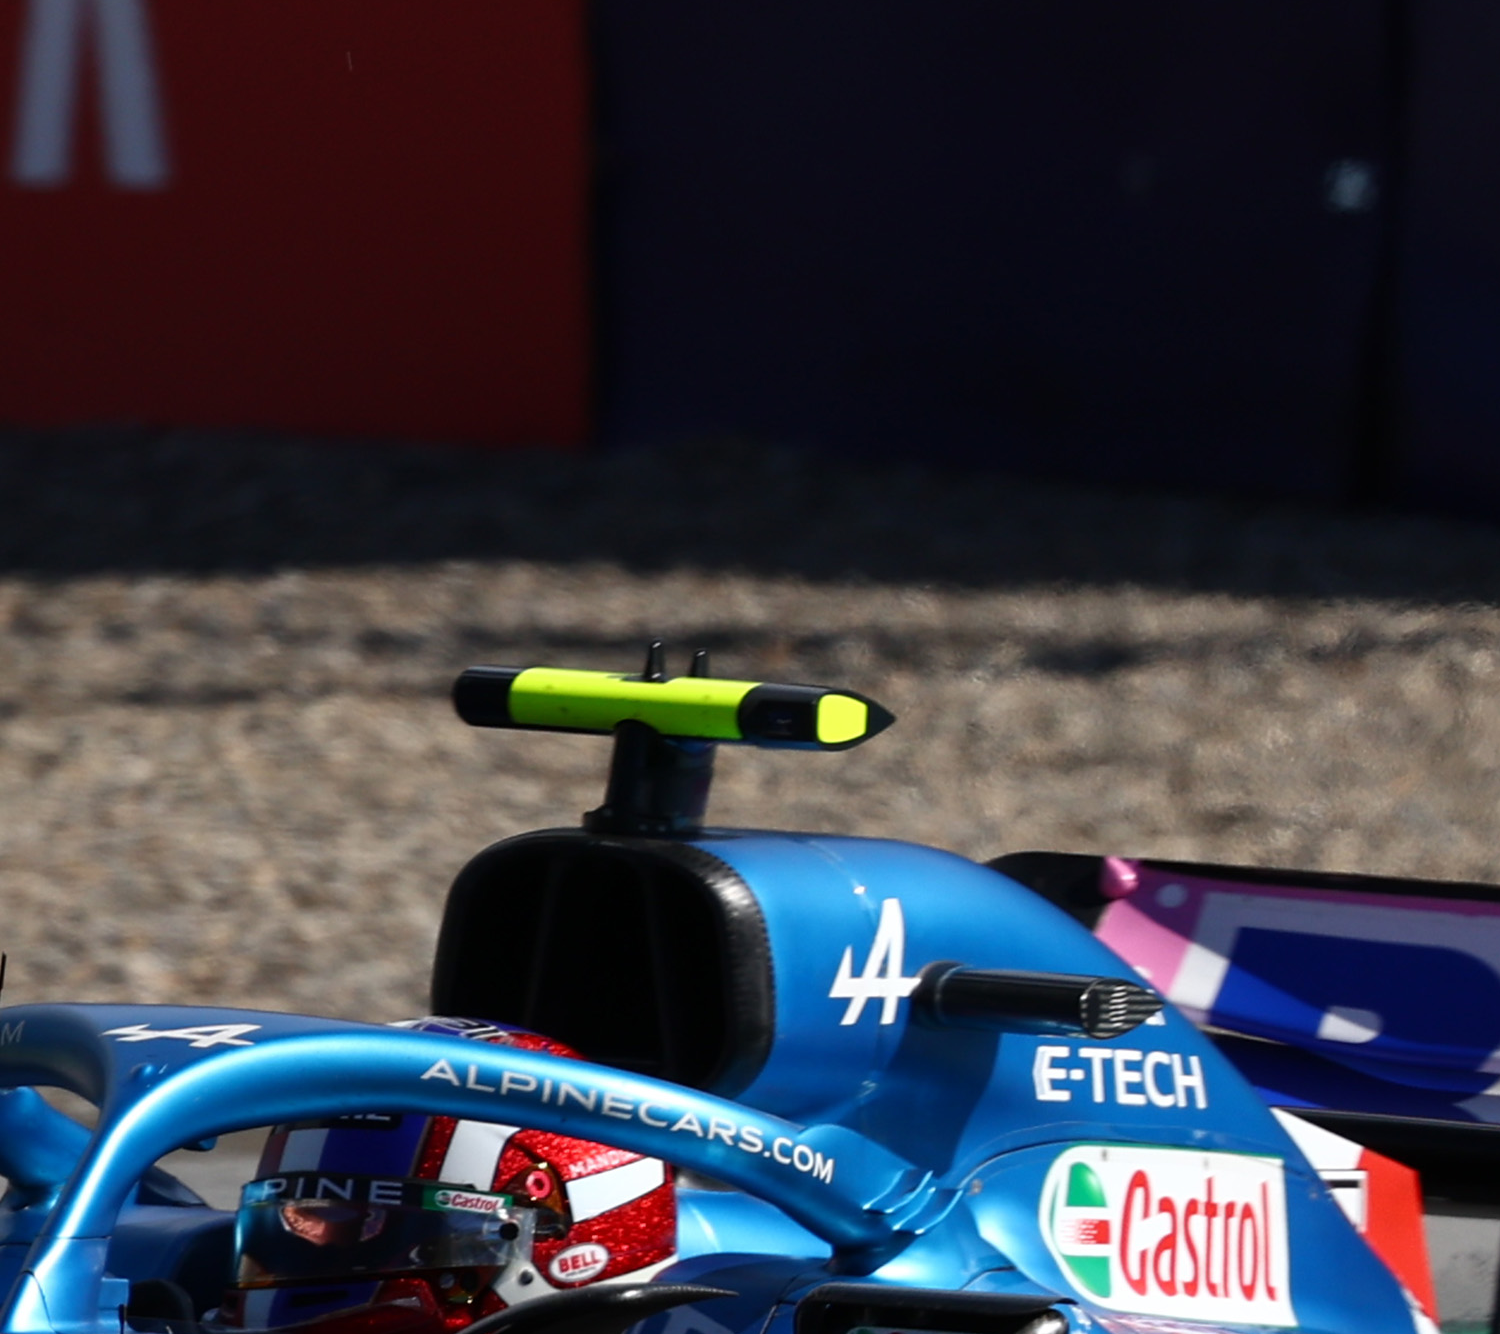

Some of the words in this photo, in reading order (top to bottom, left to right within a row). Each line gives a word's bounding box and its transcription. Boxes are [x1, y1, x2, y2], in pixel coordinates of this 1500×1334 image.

[1033, 1046, 1207, 1109] E-TECH
[420, 1059, 834, 1184] ALPINECARS.COM
[451, 1194, 501, 1211] Castrol
[558, 1252, 600, 1273] BELL
[1120, 1170, 1277, 1301] Castrol
